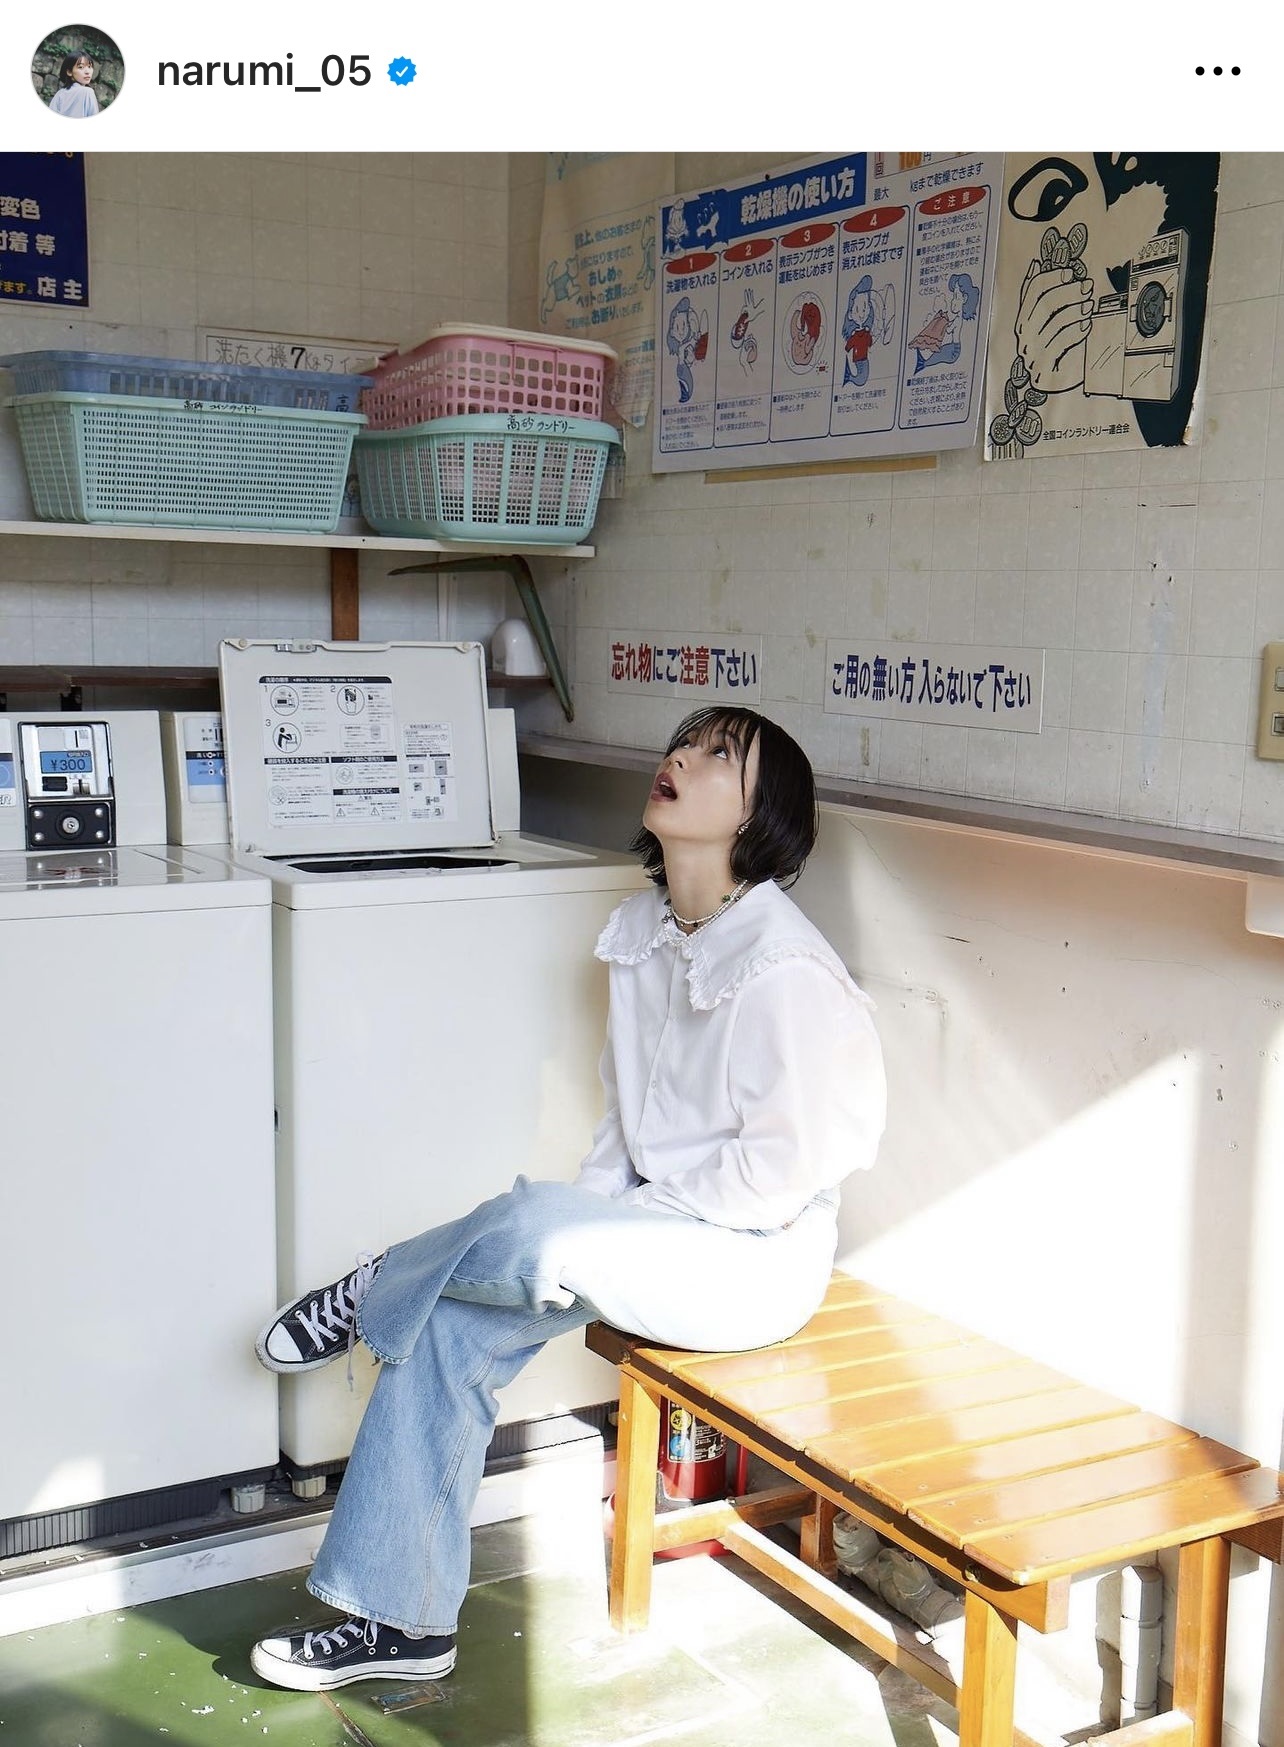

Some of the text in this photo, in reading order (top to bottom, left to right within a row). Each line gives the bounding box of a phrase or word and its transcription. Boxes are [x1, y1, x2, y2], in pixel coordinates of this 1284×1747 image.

[740, 167, 856, 226] 乾燥機の使い方
[873, 187, 890, 201] 最大
[934, 192, 970, 210] ご注意
[869, 214, 878, 227] 4
[803, 230, 811, 242] 3
[842, 234, 890, 254] 表示ランプが
[745, 244, 752, 256] 2
[778, 244, 835, 268] 表示ランプがつき
[841, 246, 904, 272] 消えれば終了です
[689, 258, 694, 270] 1
[722, 259, 774, 282] コインを入れる
[778, 261, 835, 285] 運転をはじめます
[666, 272, 717, 294] 洗濯物を入れる
[1042, 422, 1130, 441] 全国コインランドリー連合会
[611, 642, 757, 689] 忘れ物にご注意下さい
[265, 719, 271, 727] 3
[51, 759, 86, 771] ¥300
